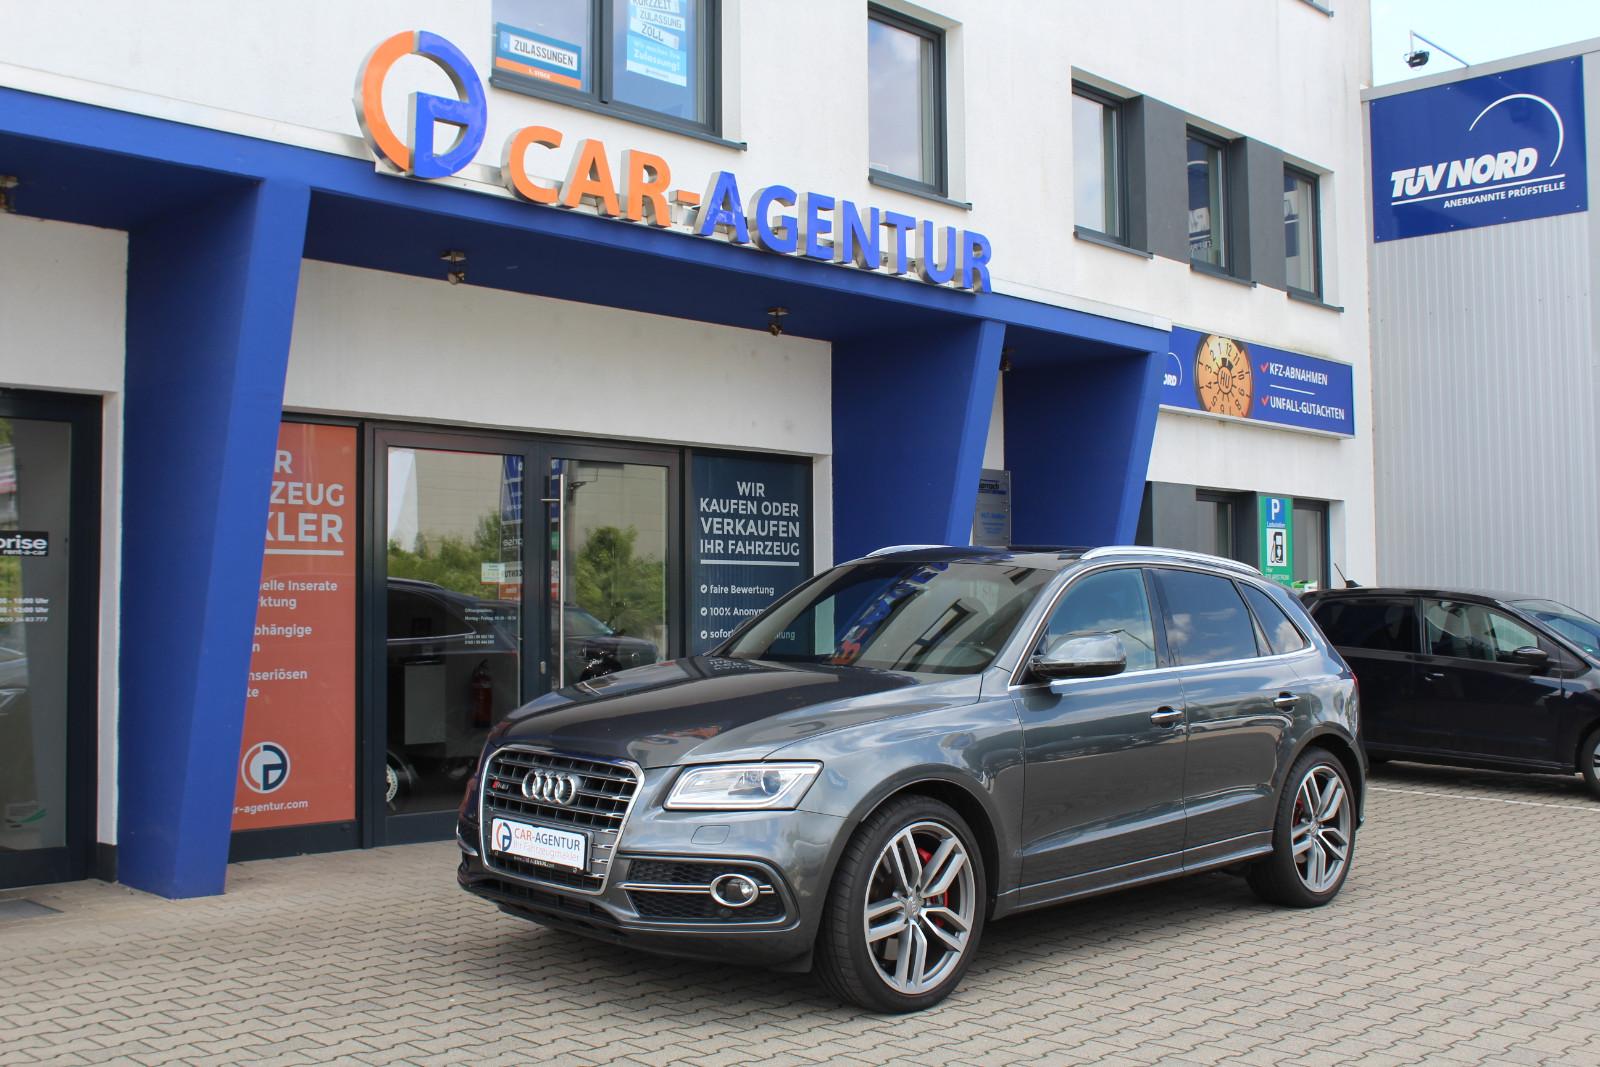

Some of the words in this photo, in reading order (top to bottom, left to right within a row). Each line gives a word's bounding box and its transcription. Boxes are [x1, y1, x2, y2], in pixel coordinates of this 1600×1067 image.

[641, 23, 664, 42] ZOLL
[514, 39, 575, 67] ZULASSUNGEN
[1391, 162, 1448, 198] TÜV
[1447, 147, 1539, 190] NORD
[1443, 192, 1506, 209] ANERKANNTE
[1507, 181, 1567, 200] PRÜFSTELLE
[500, 125, 994, 295] CAR-AGENTUR
[1269, 362, 1329, 386] KFZ-ABNAHMEN
[1270, 395, 1345, 420] UNFALL-GUTACHTEN
[736, 481, 766, 498] WIR
[700, 497, 758, 515] KAUFEN
[761, 501, 799, 517] ODER
[1271, 498, 1281, 521] P
[700, 517, 800, 538] VERKAUFEN
[700, 539, 724, 554] IHR
[728, 540, 800, 556] FAHRZEUG
[288, 580, 338, 591] Inserate
[709, 584, 729, 594] faire
[730, 585, 775, 597] Bewertung
[709, 607, 731, 616] 100%
[514, 827, 580, 851] CAR-AGENTUR
